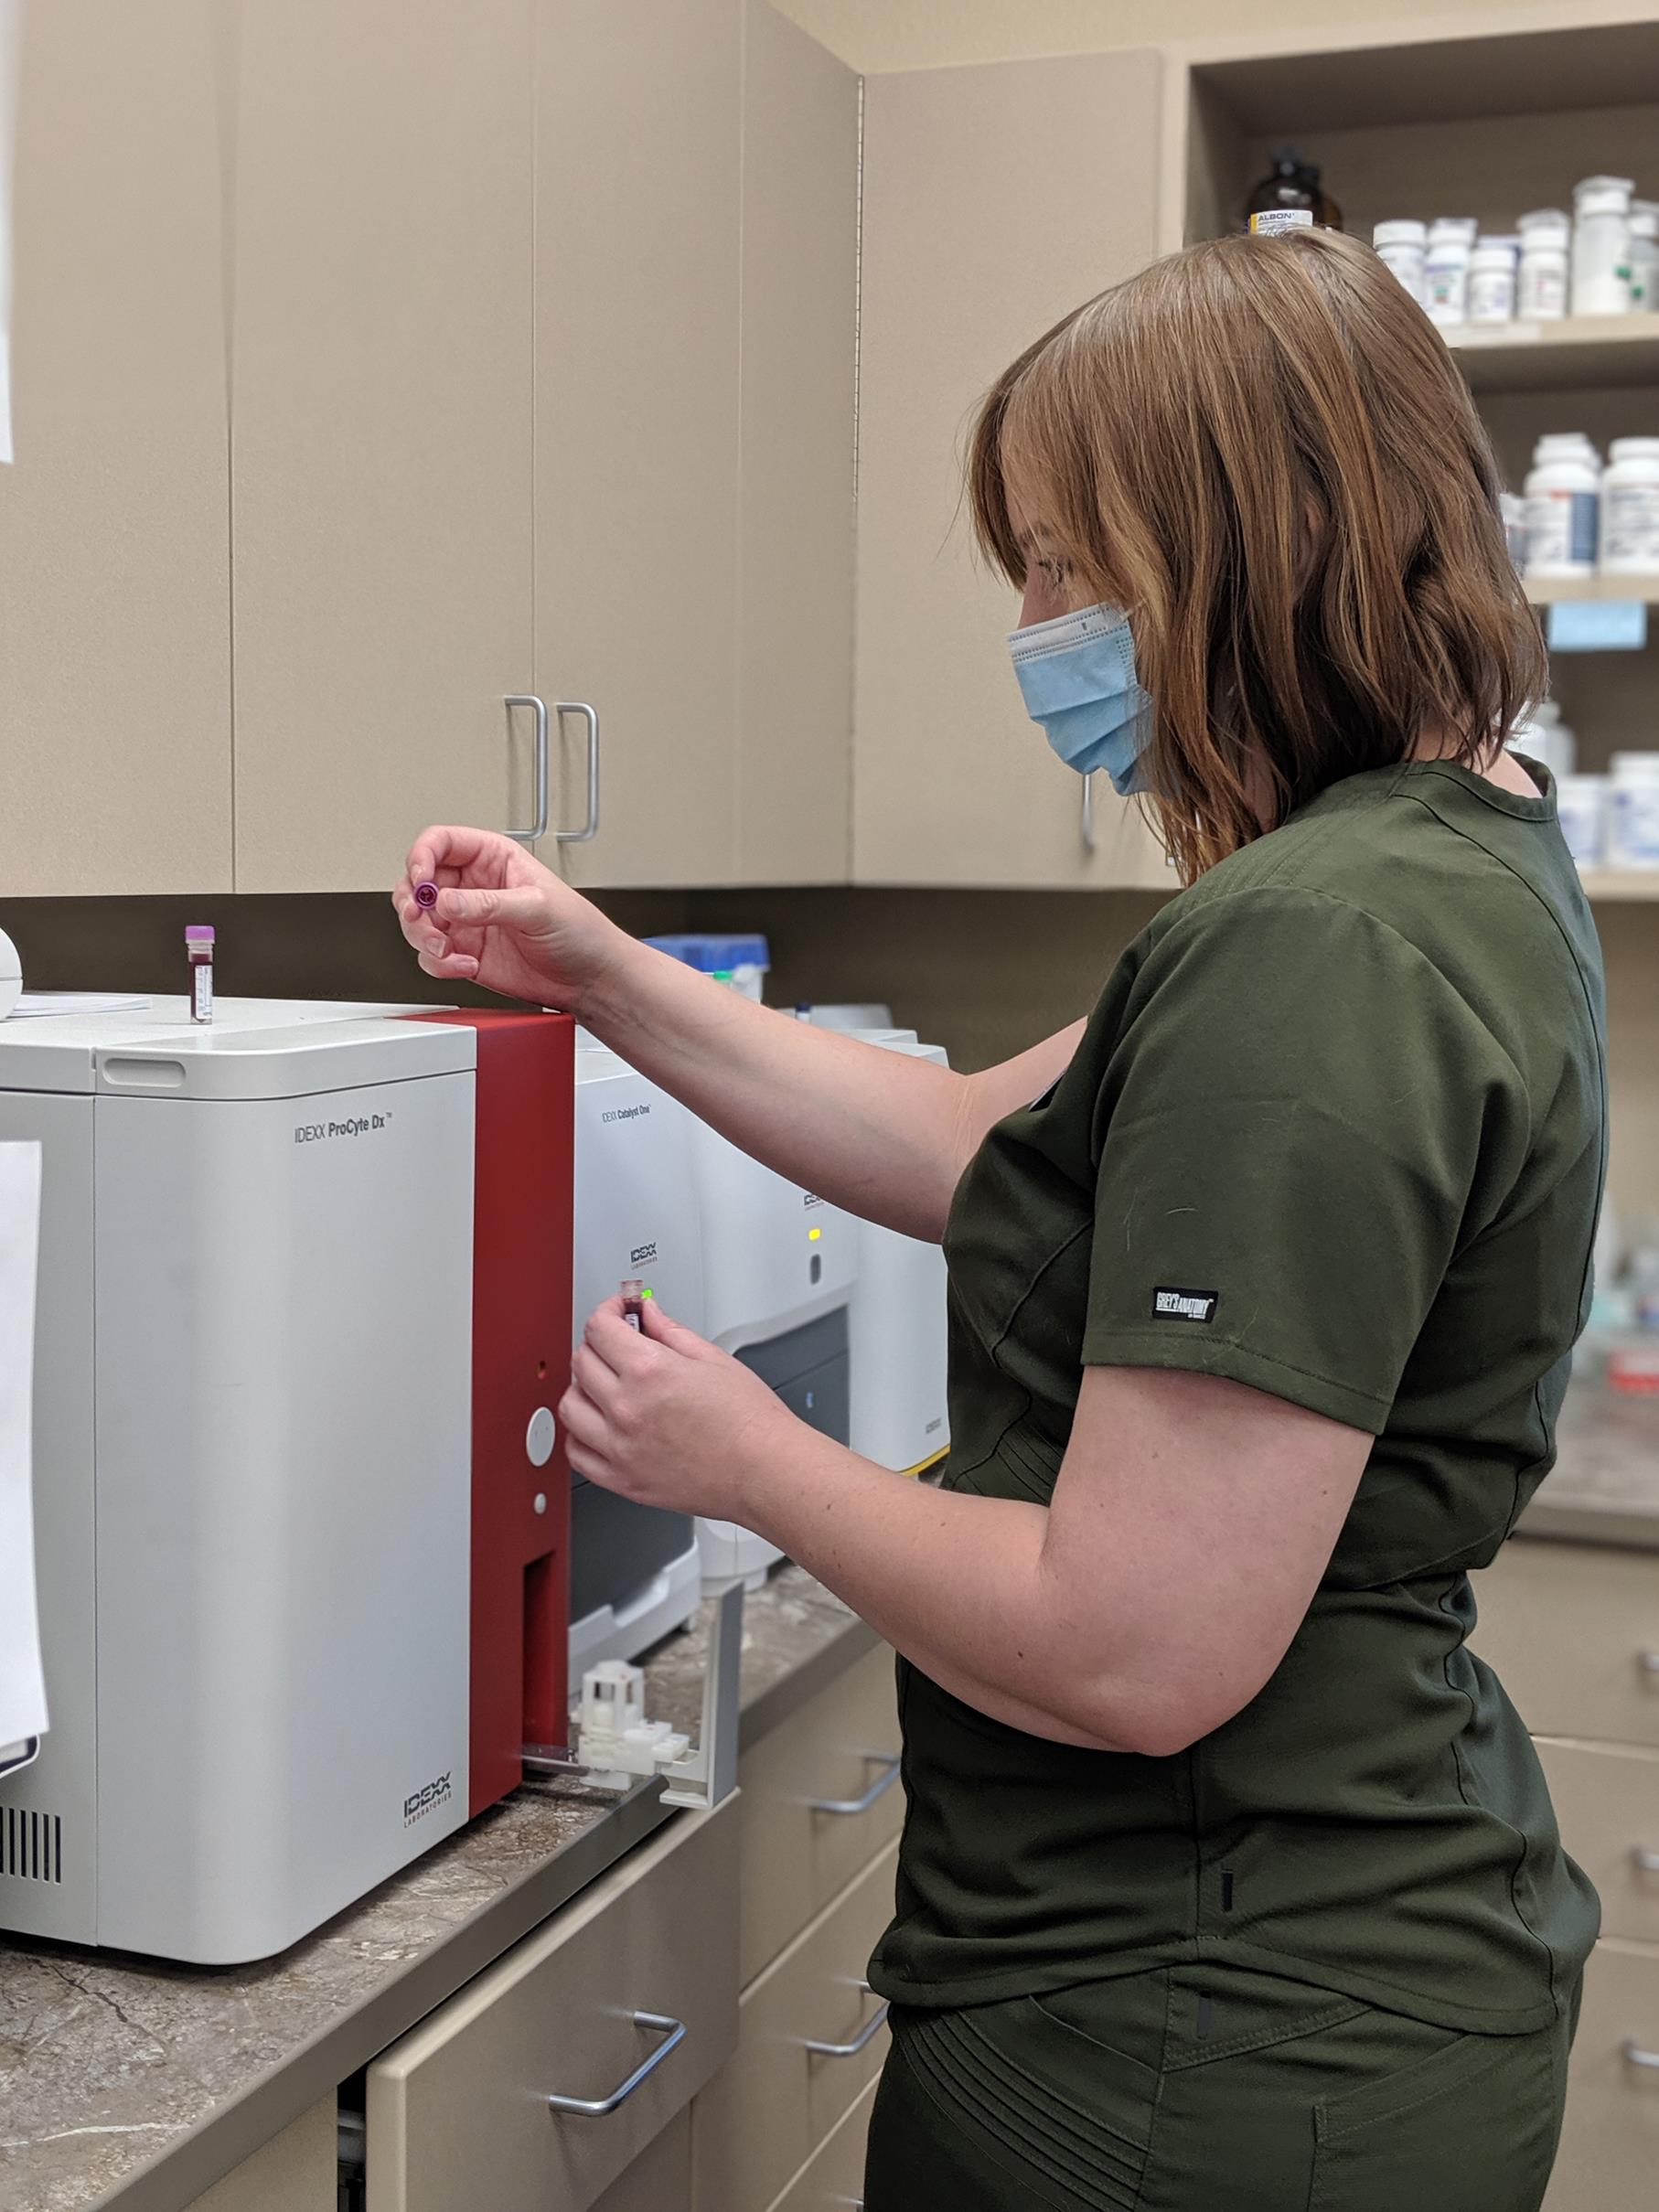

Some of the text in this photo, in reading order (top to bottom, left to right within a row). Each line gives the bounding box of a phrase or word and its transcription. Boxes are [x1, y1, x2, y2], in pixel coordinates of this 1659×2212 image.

[617, 1106, 639, 1119] Catalyst
[294, 1124, 326, 1143] IDEXX
[329, 1117, 369, 1137] ProCyte
[630, 1242, 658, 1263] IDEXX
[403, 1771, 451, 1818] IDEXX
[404, 1790, 452, 1828] LABORATORIES
